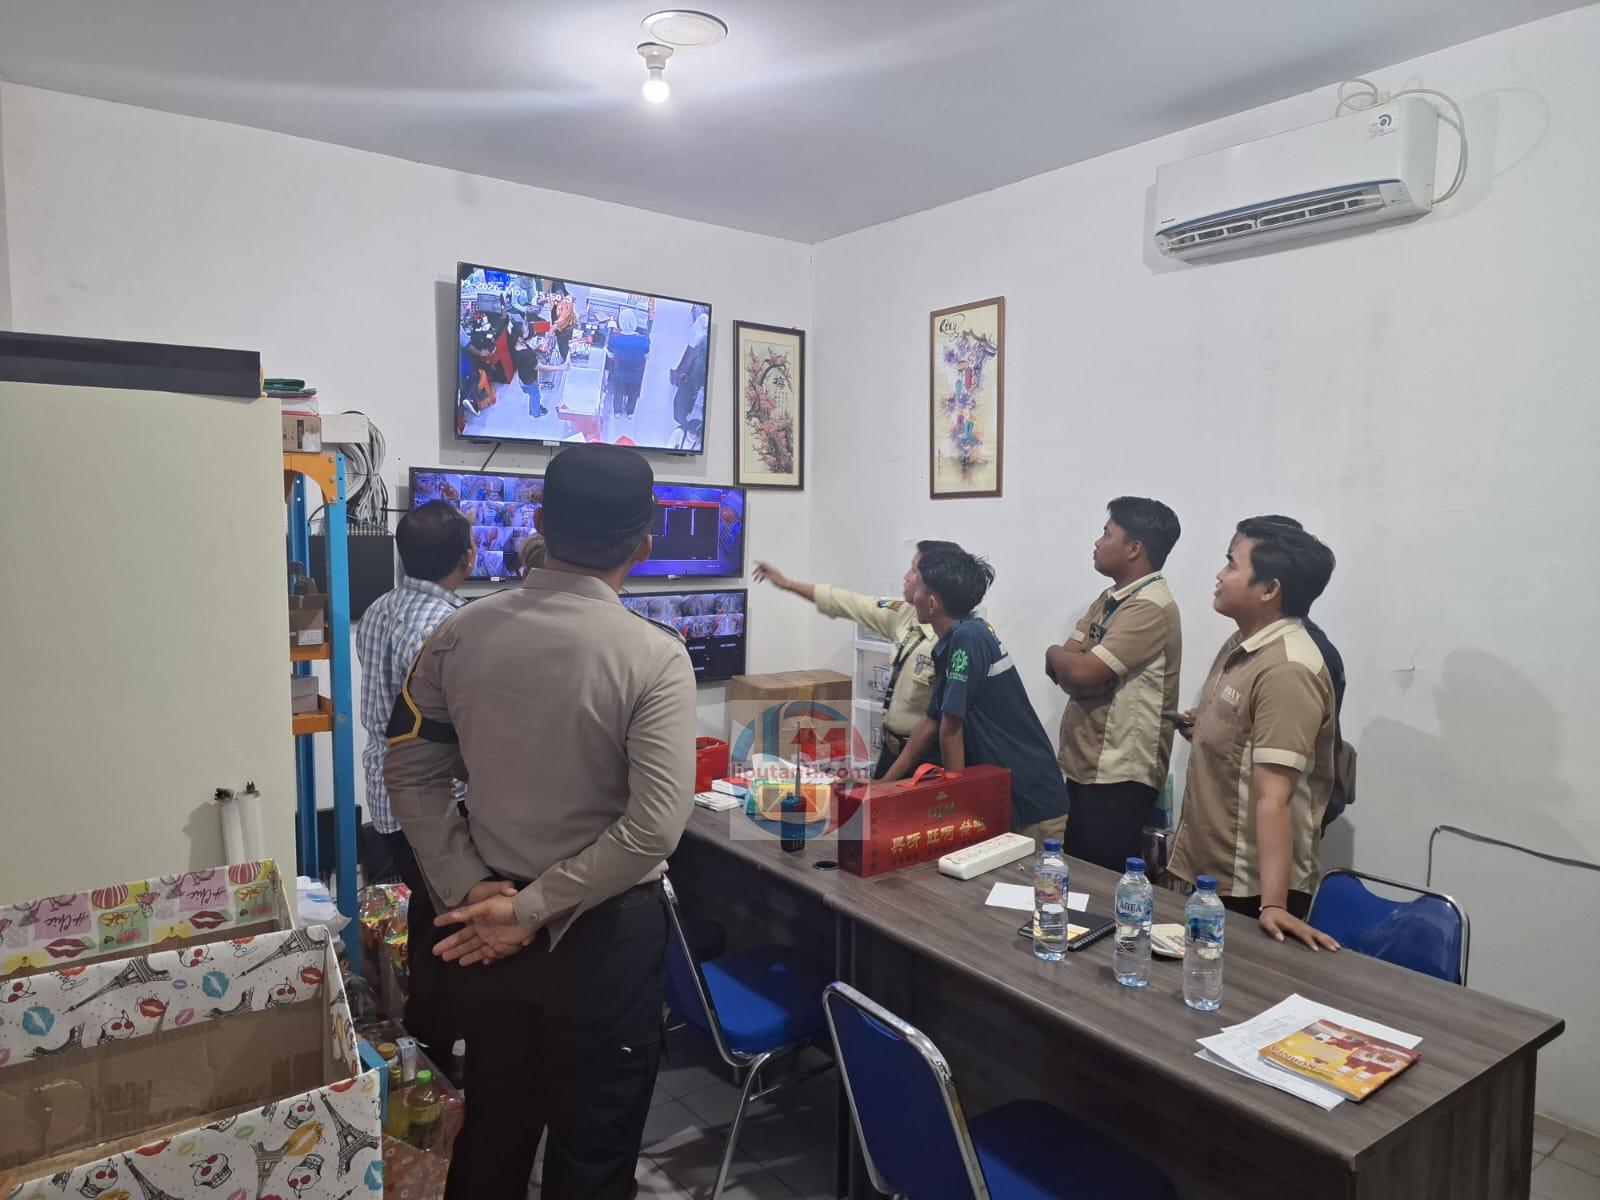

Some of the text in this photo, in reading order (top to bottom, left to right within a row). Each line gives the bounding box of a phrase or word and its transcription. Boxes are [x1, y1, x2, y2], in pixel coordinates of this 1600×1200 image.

[506, 286, 528, 297] Mon
[185, 885, 227, 905] #Chic
[1119, 901, 1143, 913] AQUA
[43, 911, 90, 934] #Chic
